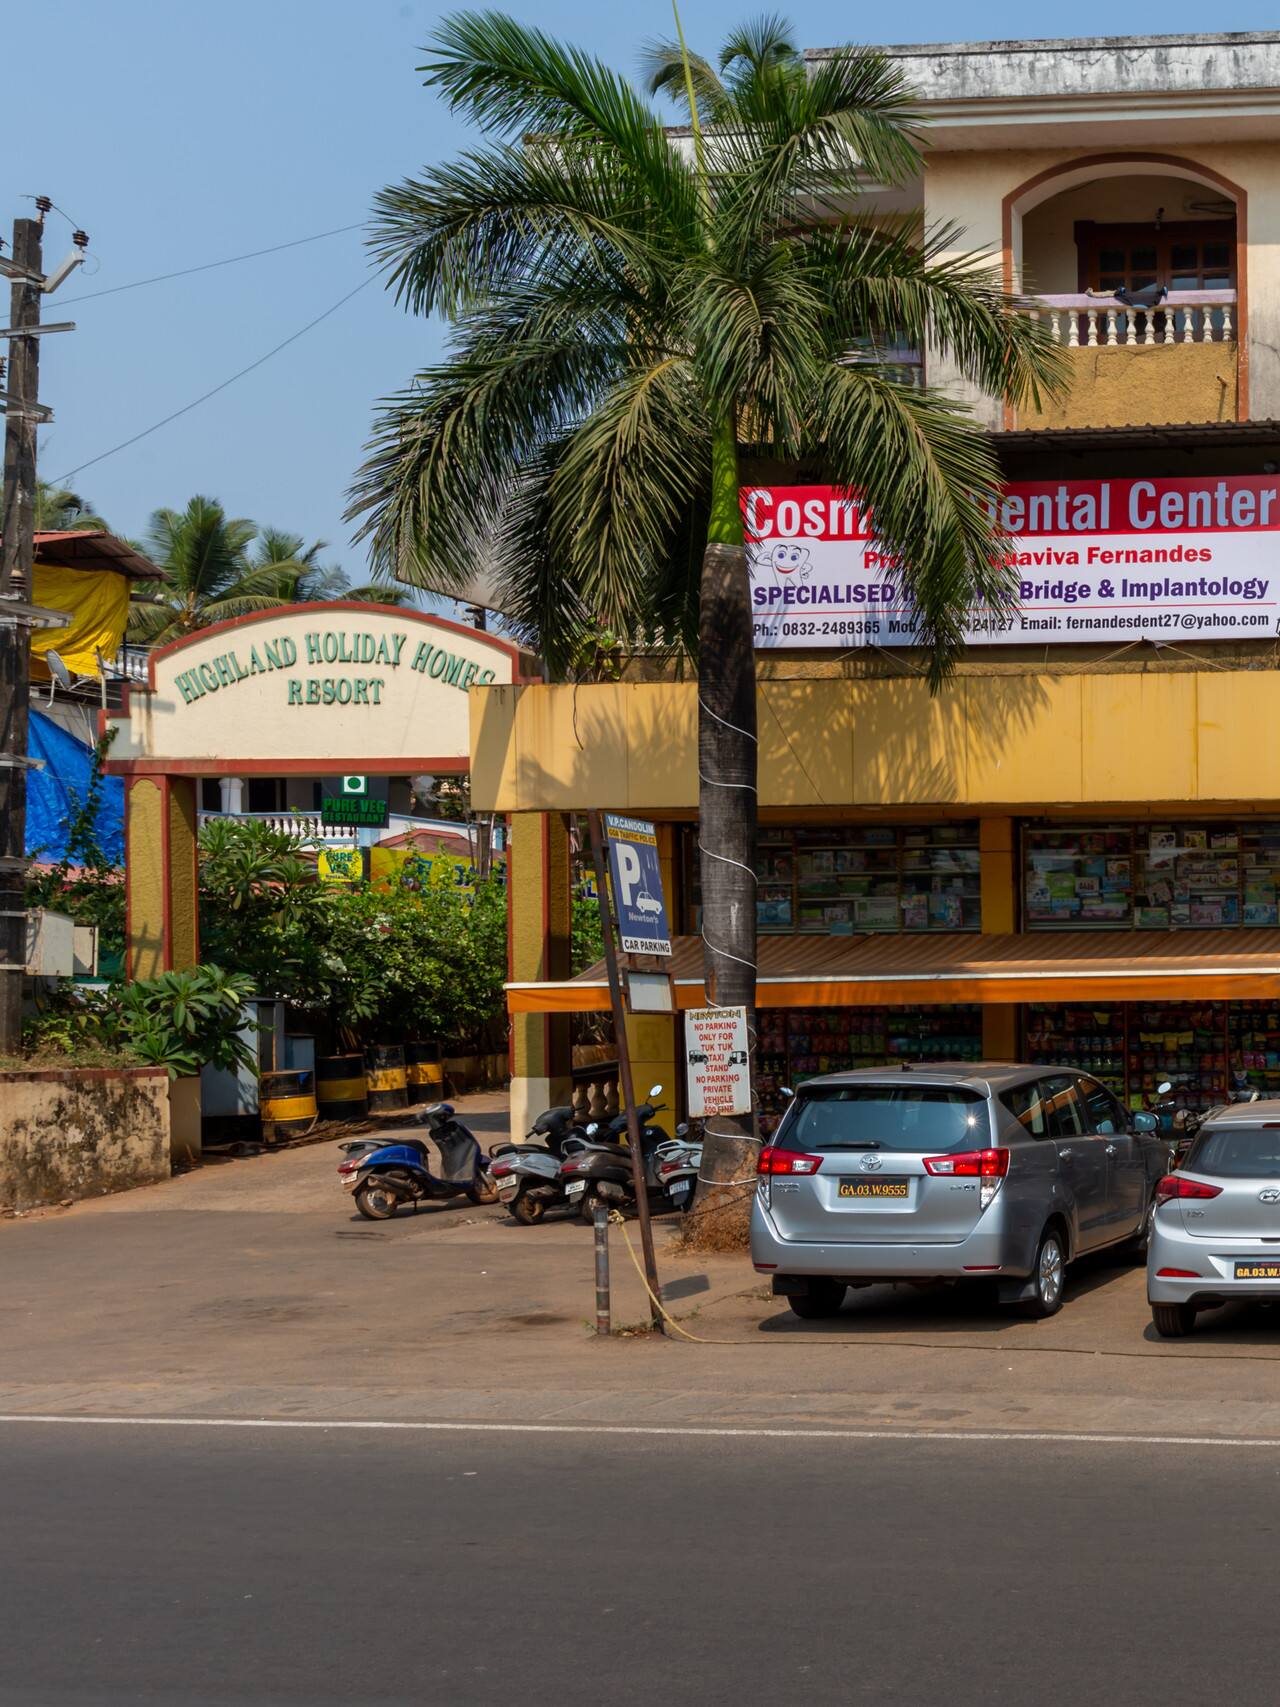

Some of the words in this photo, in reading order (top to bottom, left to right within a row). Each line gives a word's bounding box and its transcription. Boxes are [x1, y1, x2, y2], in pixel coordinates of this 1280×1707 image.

[1128, 481, 1277, 530] Center
[1087, 545, 1212, 565] Fernandes
[753, 584, 896, 605] SPECIALISED
[1019, 580, 1092, 603] Bridge
[1098, 579, 1115, 599] &
[1122, 577, 1270, 601] Implantology
[783, 621, 880, 636] 0832-2489365
[1020, 616, 1062, 631] Email:
[1066, 613, 1270, 630] fernandesdent27@yahoo.com
[174, 635, 298, 704] HIGHLAND
[304, 631, 407, 667] HOLIDAY
[410, 640, 496, 693] HOMES
[287, 678, 385, 706] RESORT
[322, 798, 358, 812] PURE
[359, 799, 386, 813] VEG
[322, 812, 386, 824] RESTAURANT
[615, 842, 641, 906] P
[628, 911, 659, 924] Newton's
[624, 939, 640, 950] CAR
[640, 941, 670, 953] PARKING
[689, 1010, 741, 1020] NEWTON
[694, 1023, 703, 1031] NO
[705, 1021, 737, 1030] PARKING
[699, 1033, 716, 1041] ONLY
[718, 1032, 733, 1040] FOR
[718, 1043, 733, 1051] TUK
[708, 1053, 724, 1061] TAXI
[705, 1064, 728, 1072] STAND
[696, 1075, 706, 1083] NO
[707, 1074, 740, 1082] PARKING
[703, 1085, 732, 1093] PRIVATE
[704, 1095, 734, 1104] VEHICLE
[839, 1183, 907, 1196] GA.03.W.9555
